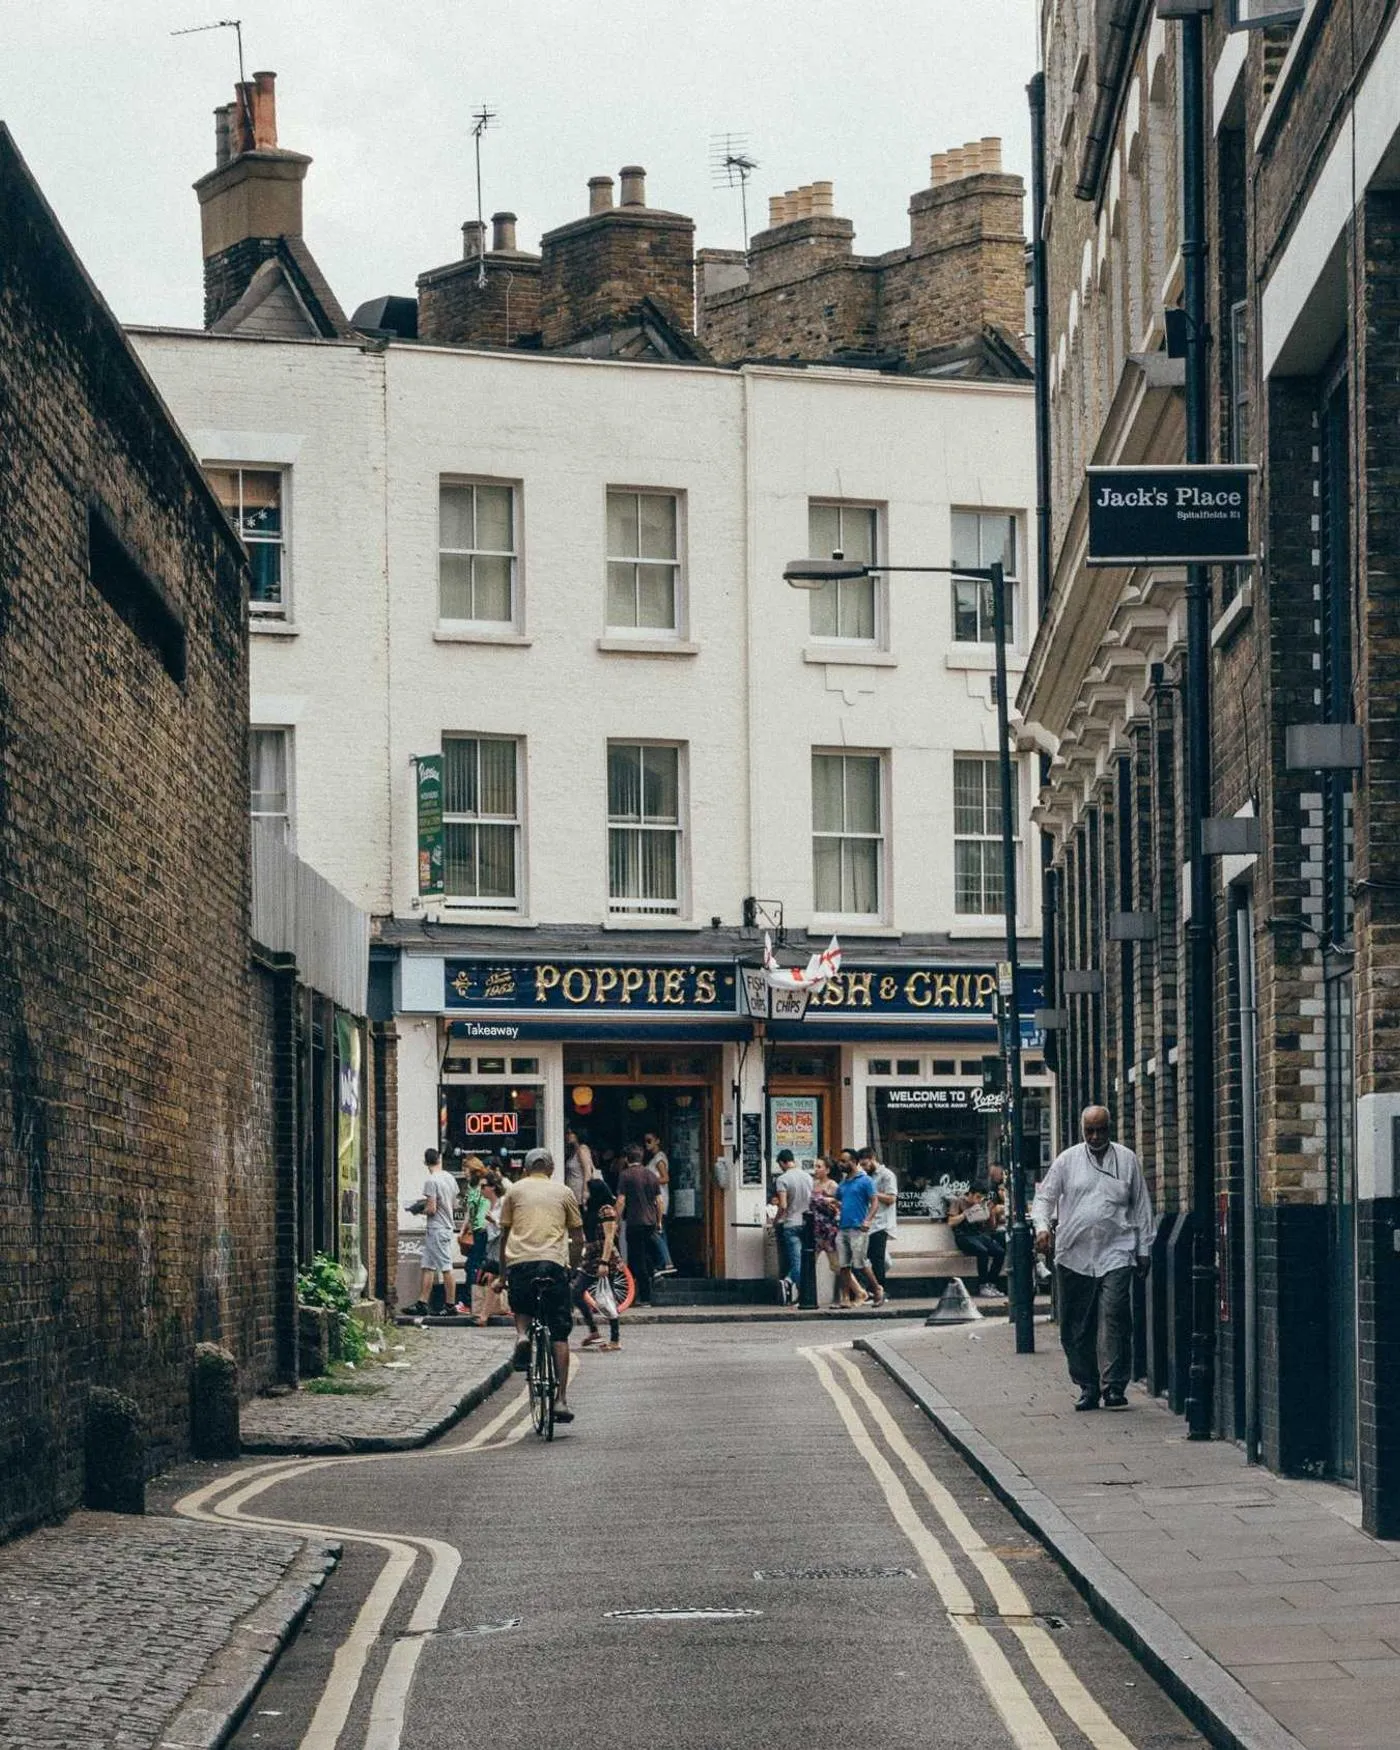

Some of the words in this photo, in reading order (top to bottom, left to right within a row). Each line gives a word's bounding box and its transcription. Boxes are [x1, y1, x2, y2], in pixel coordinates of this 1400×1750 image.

[1096, 487, 1169, 507] Jack's
[1176, 487, 1241, 507] Place
[1176, 510, 1228, 521] Spitalfields
[534, 964, 718, 1004] POPPIE'S
[879, 976, 899, 1000] &
[904, 971, 997, 1008] CHIP
[747, 975, 766, 992] FISH
[775, 1000, 801, 1013] CHIPS
[464, 1022, 519, 1039] Takeaway
[889, 1090, 947, 1102] WELCOME
[949, 1090, 966, 1102] TO
[467, 1114, 517, 1133] OPEN
